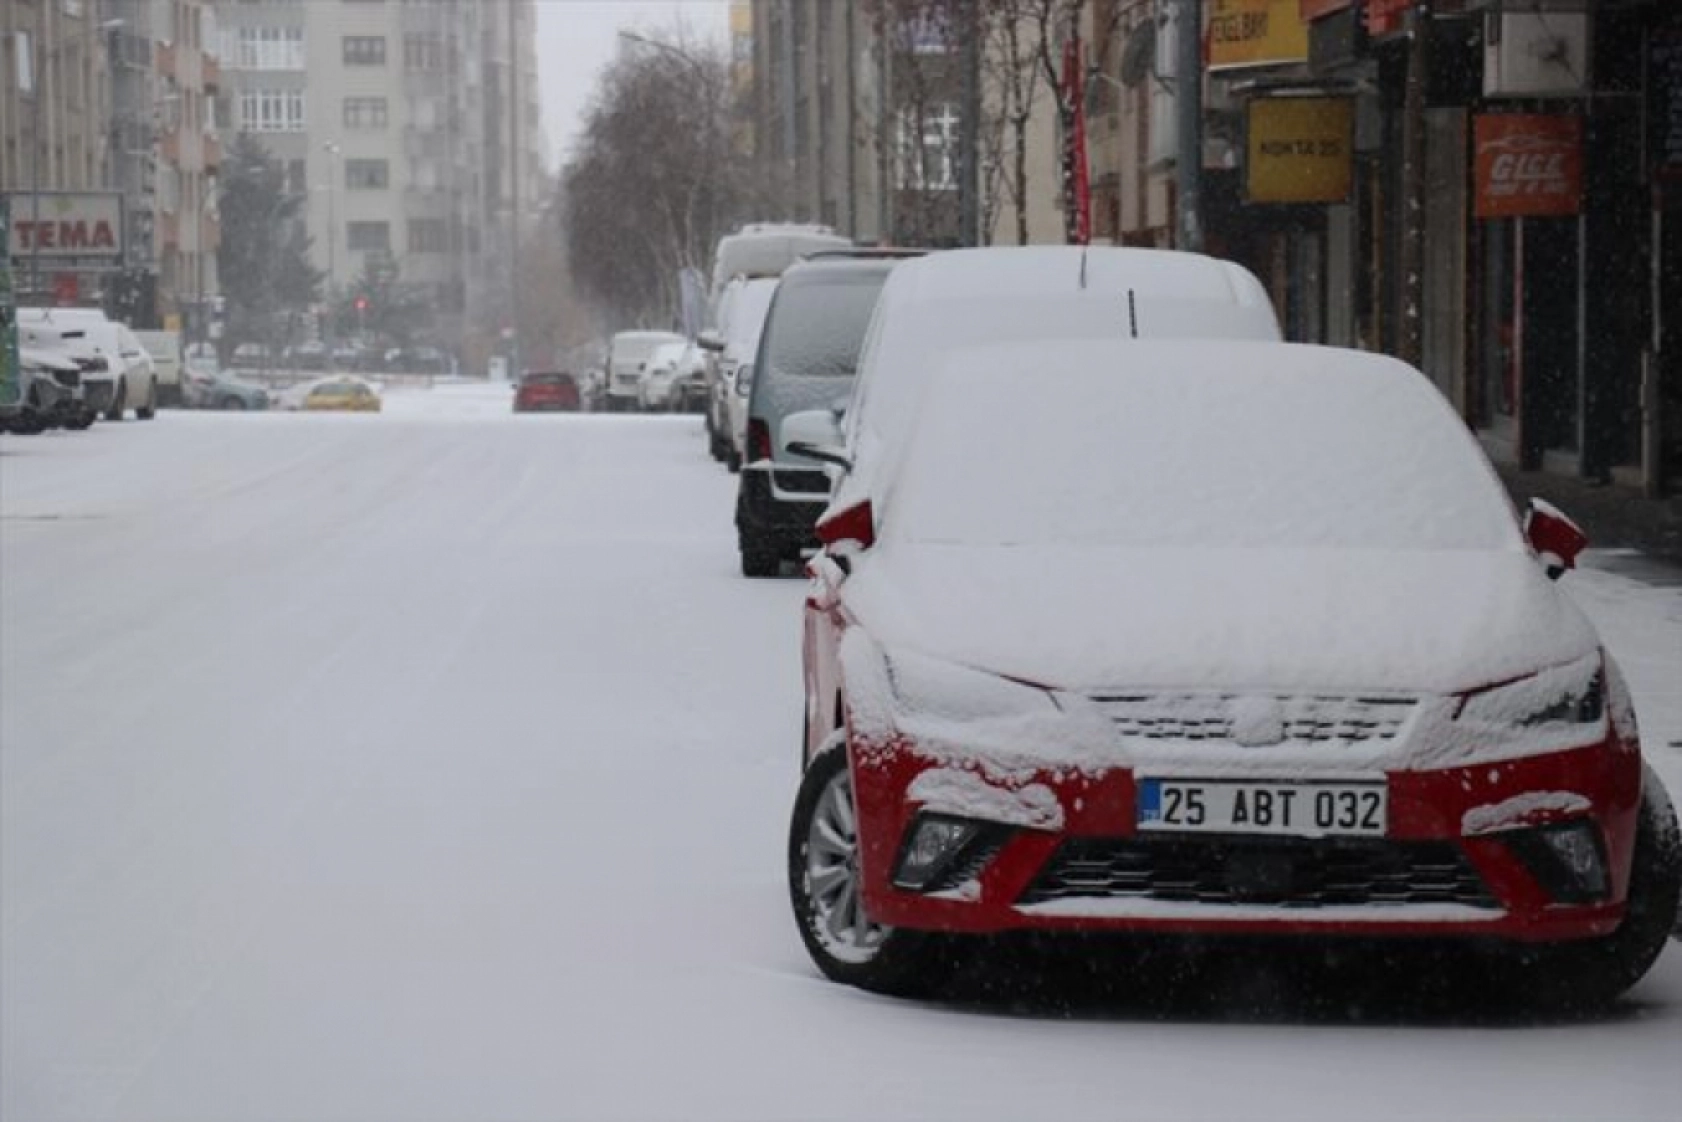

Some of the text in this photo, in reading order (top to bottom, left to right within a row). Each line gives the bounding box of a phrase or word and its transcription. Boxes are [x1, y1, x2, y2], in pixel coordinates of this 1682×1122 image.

[14, 220, 114, 248] TEMA
[1163, 788, 1381, 830] 25 ABT 032
